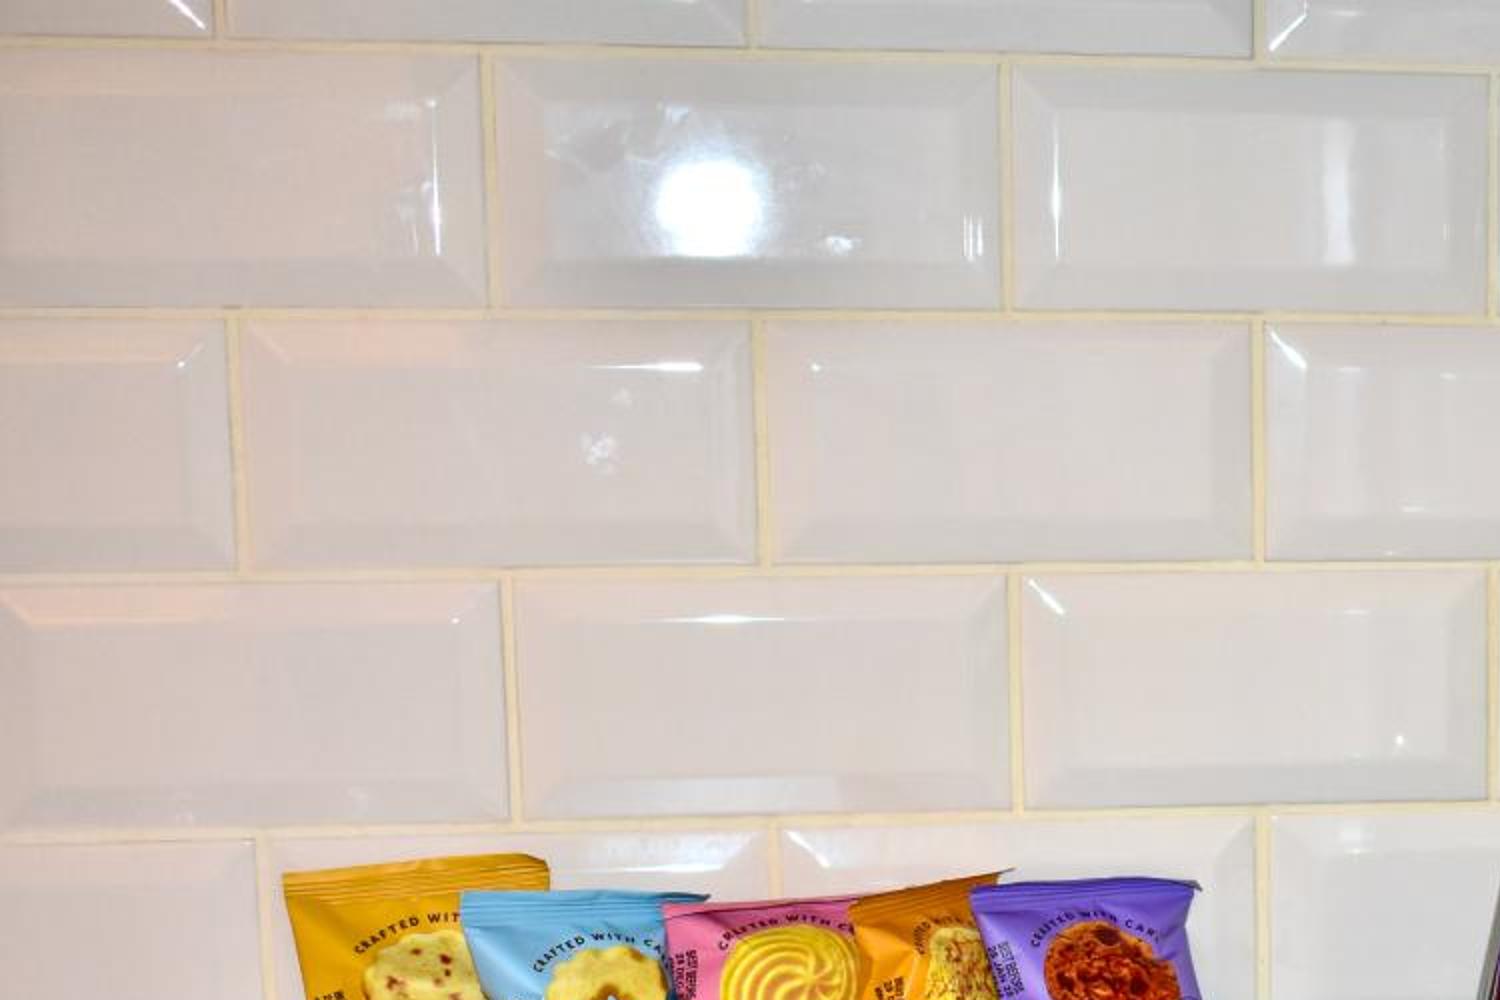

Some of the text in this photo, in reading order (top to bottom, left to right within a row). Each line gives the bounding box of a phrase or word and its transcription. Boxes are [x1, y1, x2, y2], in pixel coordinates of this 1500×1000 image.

[354, 916, 420, 954] CRAFTED
[1079, 911, 1118, 923] WITH
[532, 935, 585, 973] CRAFTED
[591, 932, 635, 944] WITH
